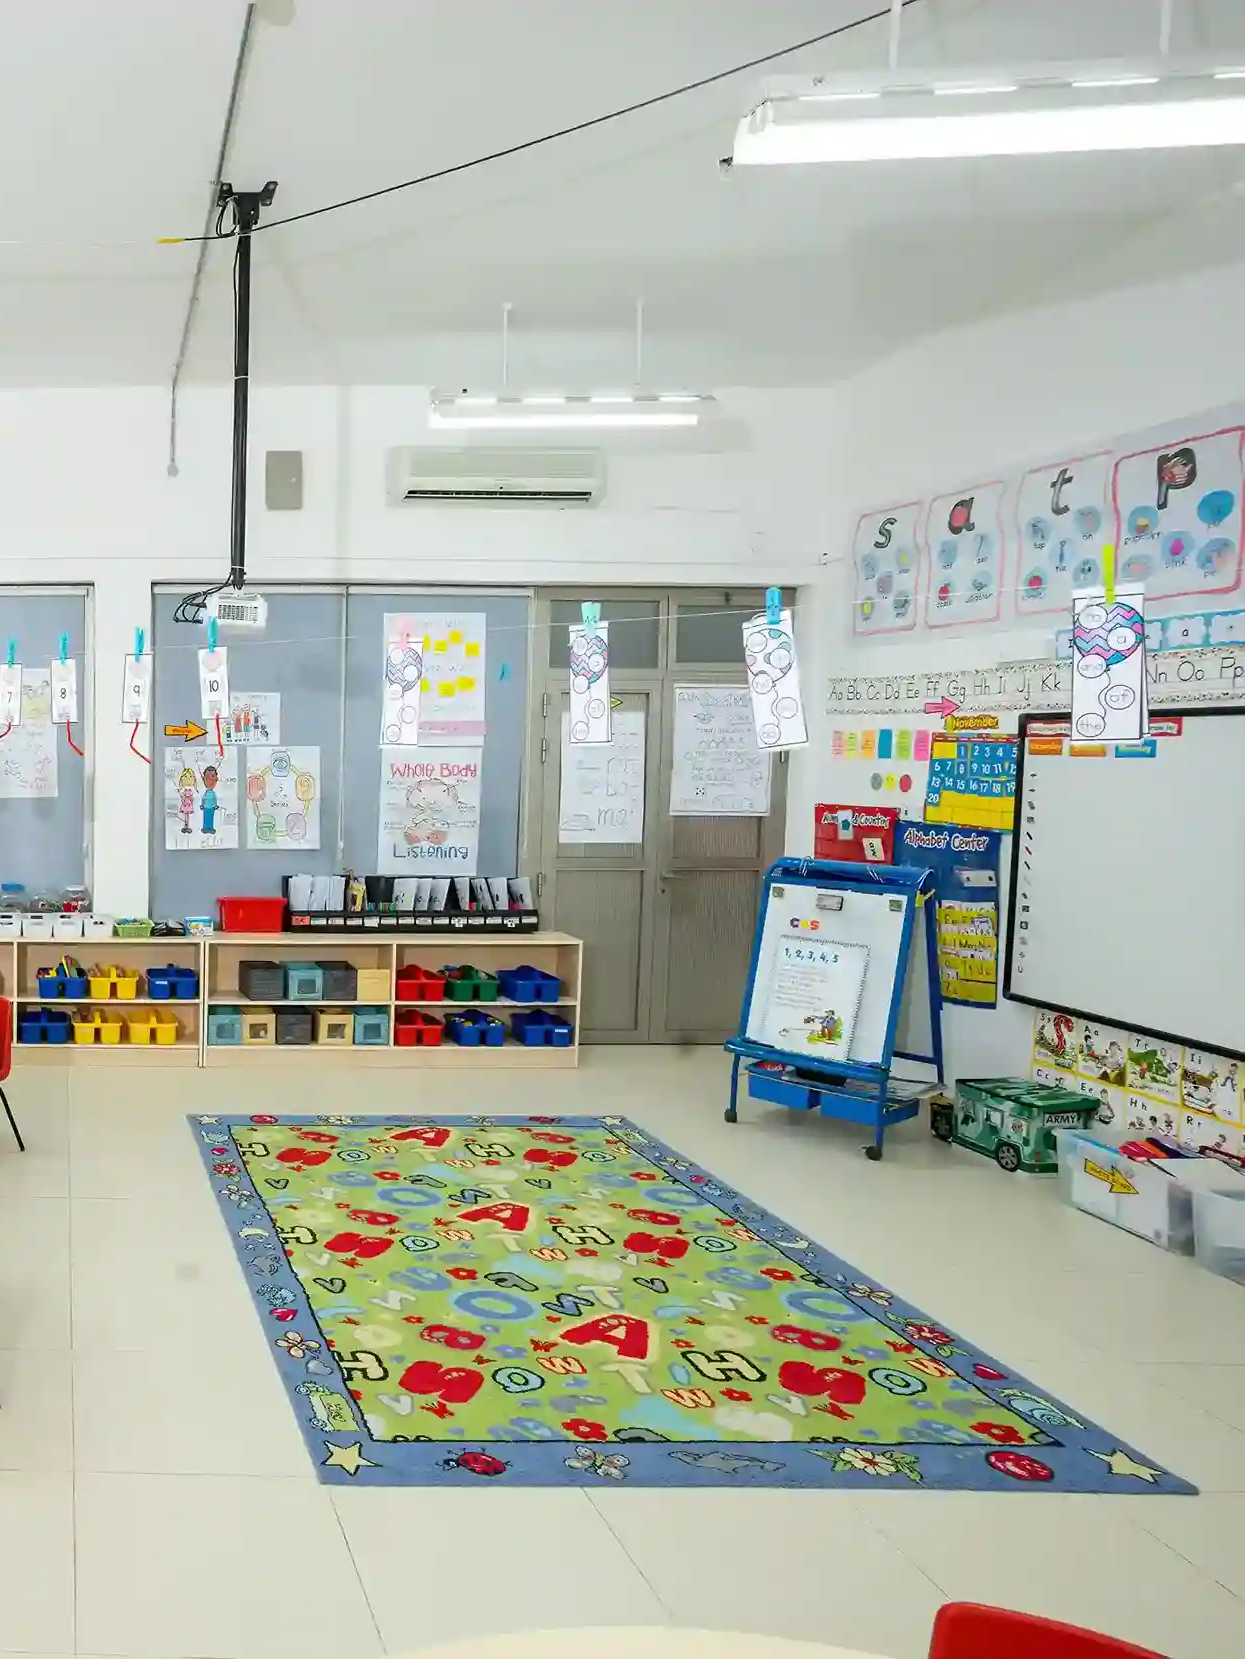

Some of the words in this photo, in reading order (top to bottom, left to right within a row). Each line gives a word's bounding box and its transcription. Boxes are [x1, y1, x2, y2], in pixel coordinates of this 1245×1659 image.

[1050, 467, 1074, 516] t
[948, 496, 976, 535] a
[208, 679, 220, 693] 10
[846, 684, 862, 701] Bb
[866, 684, 880, 700] Cc
[885, 683, 900, 700] Dd
[906, 682, 920, 699] Ee
[947, 679, 967, 704] Gg
[973, 677, 991, 695] Hh
[1016, 676, 1031, 701] Jj
[1041, 673, 1061, 691] Kk
[1177, 660, 1205, 682] Oo
[1220, 656, 1245, 689] Pp
[7, 691, 13, 704] 7
[60, 687, 67, 700] 8
[132, 683, 141, 698] 9
[973, 745, 980, 756] 2
[984, 746, 991, 757] 3
[996, 747, 1003, 757] 4
[934, 761, 941, 771] 6
[945, 761, 952, 771] 7
[971, 763, 978, 772] 9
[981, 764, 990, 774] 10
[993, 763, 1002, 773] 11
[931, 776, 941, 788] 13
[944, 777, 953, 787] 14
[956, 779, 965, 790] 15
[979, 783, 988, 793] 17
[992, 783, 1001, 793] 18
[927, 793, 939, 803] 20
[904, 827, 949, 849] Alphabet
[950, 832, 989, 852] Center
[393, 843, 469, 860] Listening
[1045, 1114, 1078, 1126] ARMY
